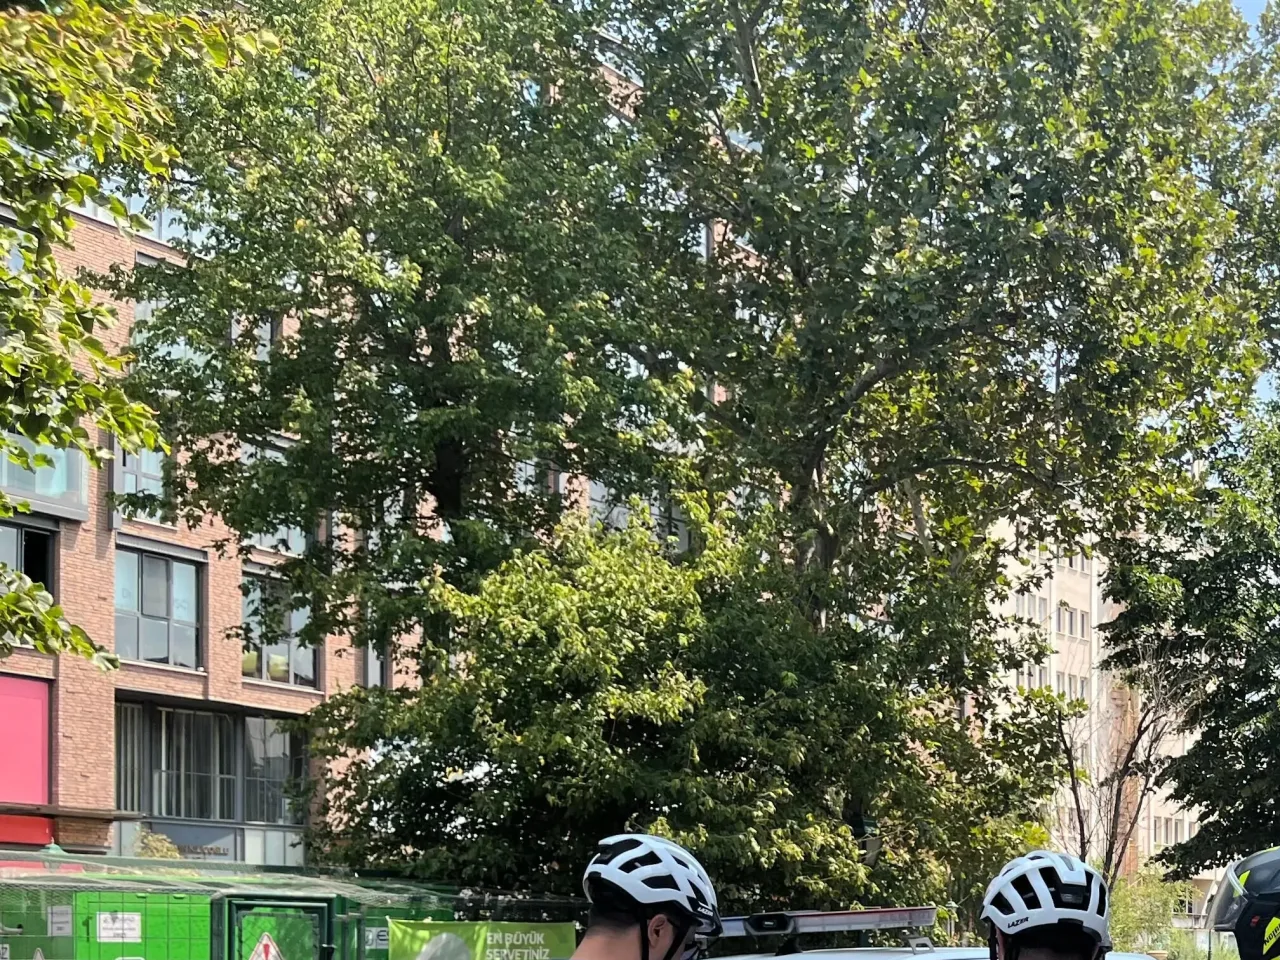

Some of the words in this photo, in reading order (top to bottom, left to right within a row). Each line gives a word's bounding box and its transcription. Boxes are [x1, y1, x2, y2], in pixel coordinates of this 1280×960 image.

[1007, 917, 1029, 929] LAZER
[486, 933, 503, 944] EN
[505, 932, 545, 945] BÜYÜK
[486, 946, 550, 960] SERVETİNİZ
